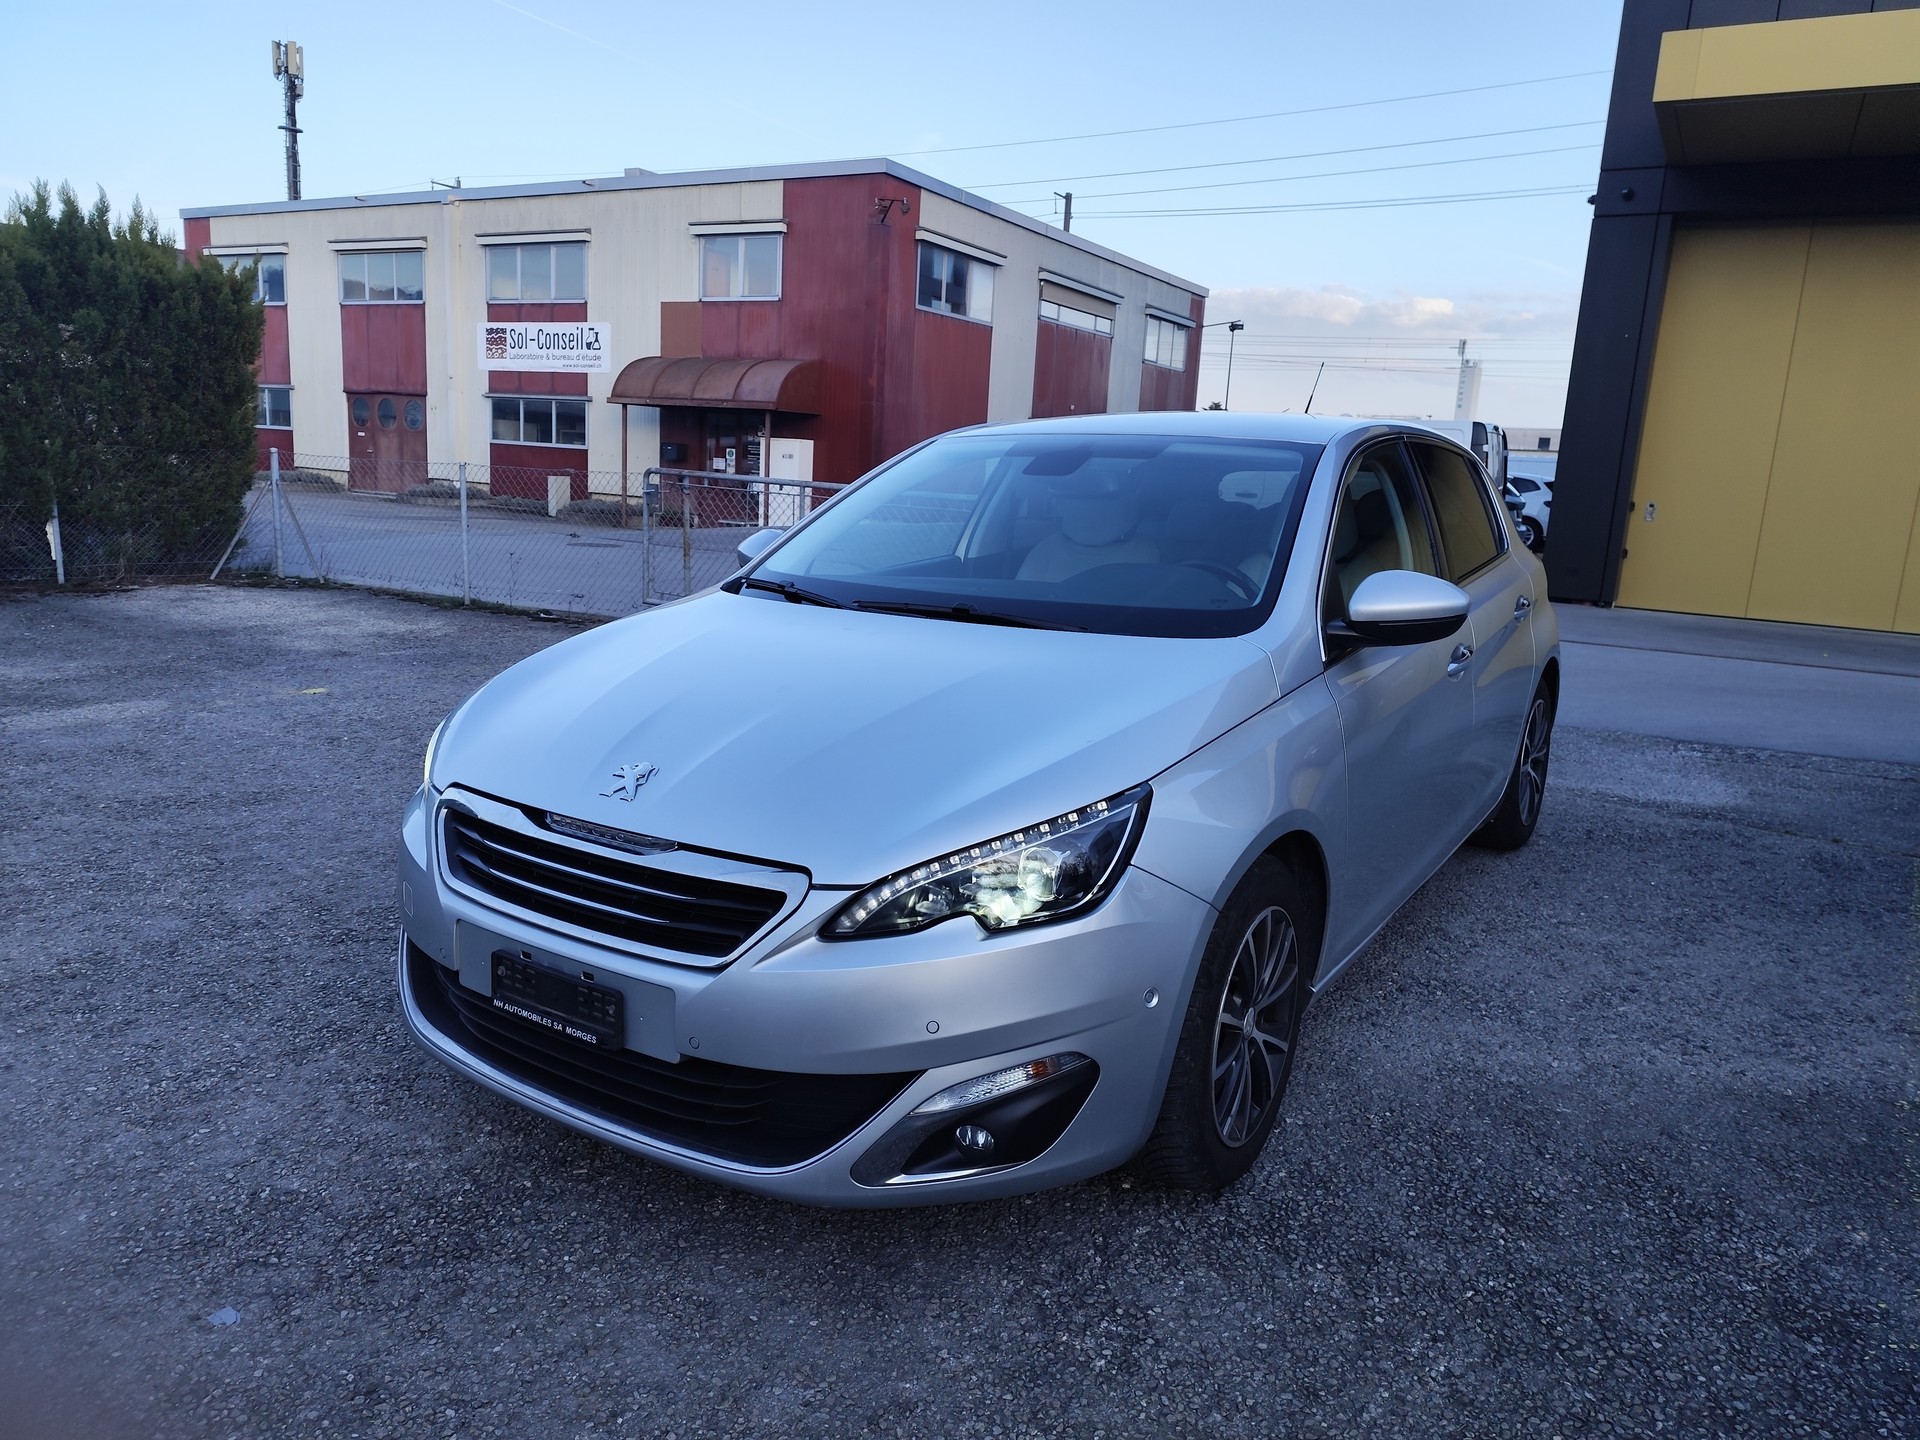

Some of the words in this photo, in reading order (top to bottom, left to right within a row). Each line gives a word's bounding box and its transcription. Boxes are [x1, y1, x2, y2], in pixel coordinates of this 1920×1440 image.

[509, 326, 584, 351] Sol-Conseil
[509, 352, 545, 361] Laboratoire
[546, 353, 551, 361] &
[551, 352, 575, 361] bureau
[493, 999, 504, 1009] NH
[503, 1003, 552, 1027] AUTOMOBILES
[552, 1021, 563, 1032] SA
[565, 1026, 597, 1044] MORGES
